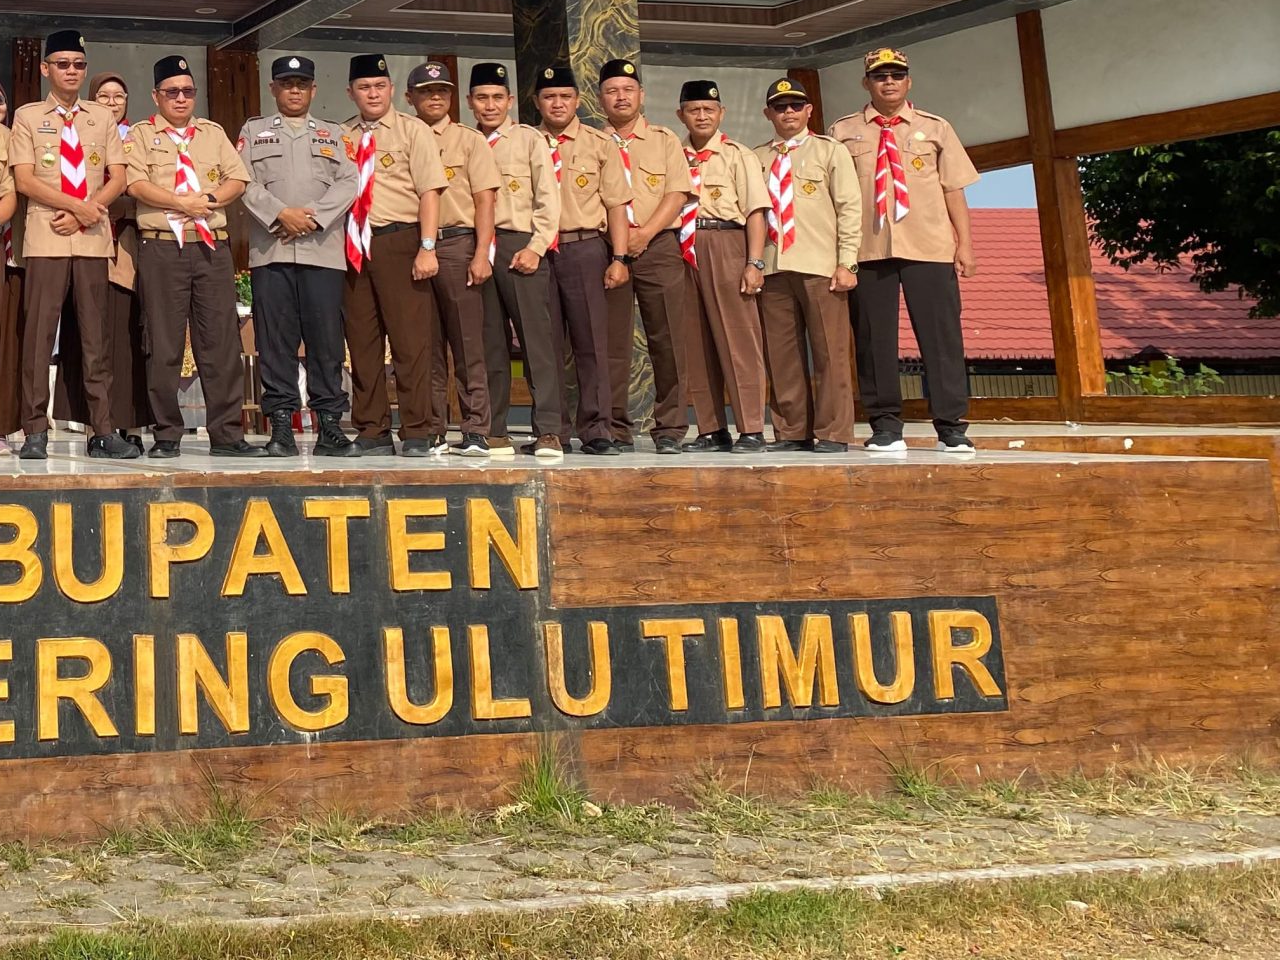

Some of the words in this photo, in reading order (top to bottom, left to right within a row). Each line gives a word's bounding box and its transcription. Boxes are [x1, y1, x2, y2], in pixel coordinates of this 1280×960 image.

[312, 138, 338, 147] POLRI
[381, 620, 613, 726] ULU
[641, 609, 1004, 713] TIMUR
